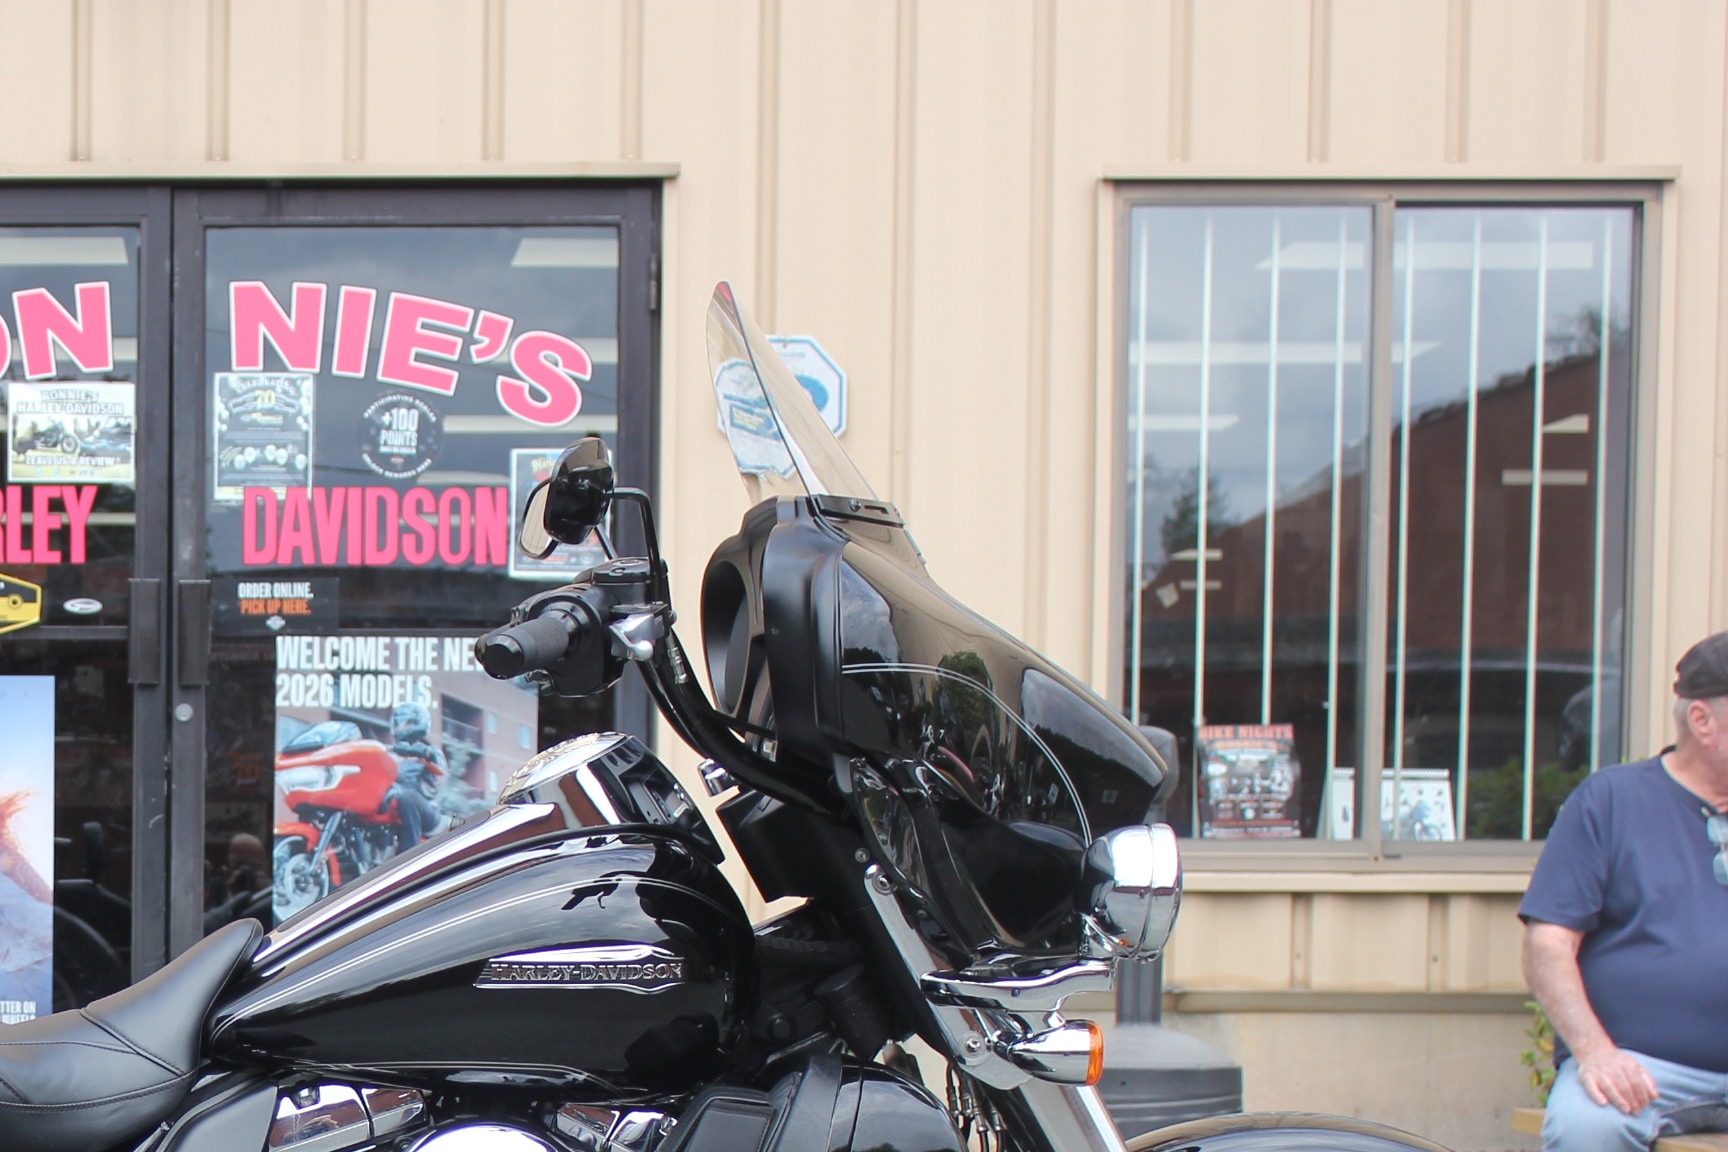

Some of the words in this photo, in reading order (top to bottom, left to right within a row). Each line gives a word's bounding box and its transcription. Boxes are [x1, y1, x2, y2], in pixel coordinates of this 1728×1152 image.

[228, 280, 593, 428] NIE'S
[41, 389, 100, 401] RONNIE'S
[16, 401, 125, 415] HARLEY-DAVIDSON
[381, 407, 419, 431] +100
[379, 429, 418, 447] POINTS
[25, 455, 54, 466] LEAVE
[55, 455, 68, 466] US
[79, 456, 116, 467] REVIEW
[242, 486, 508, 566] DAVIDSON
[237, 582, 272, 599] ORDER
[273, 582, 314, 599] ONLINE.
[240, 598, 266, 615] PICK
[267, 598, 282, 615] UP
[282, 598, 312, 615] HERE.
[275, 636, 391, 671] WELCOME
[394, 637, 439, 672] THE
[275, 673, 335, 708] 2026
[339, 674, 439, 709] MODELS.
[489, 962, 684, 982] HARLEY-DAVIDSON
[22, 1000, 37, 1014] ON
